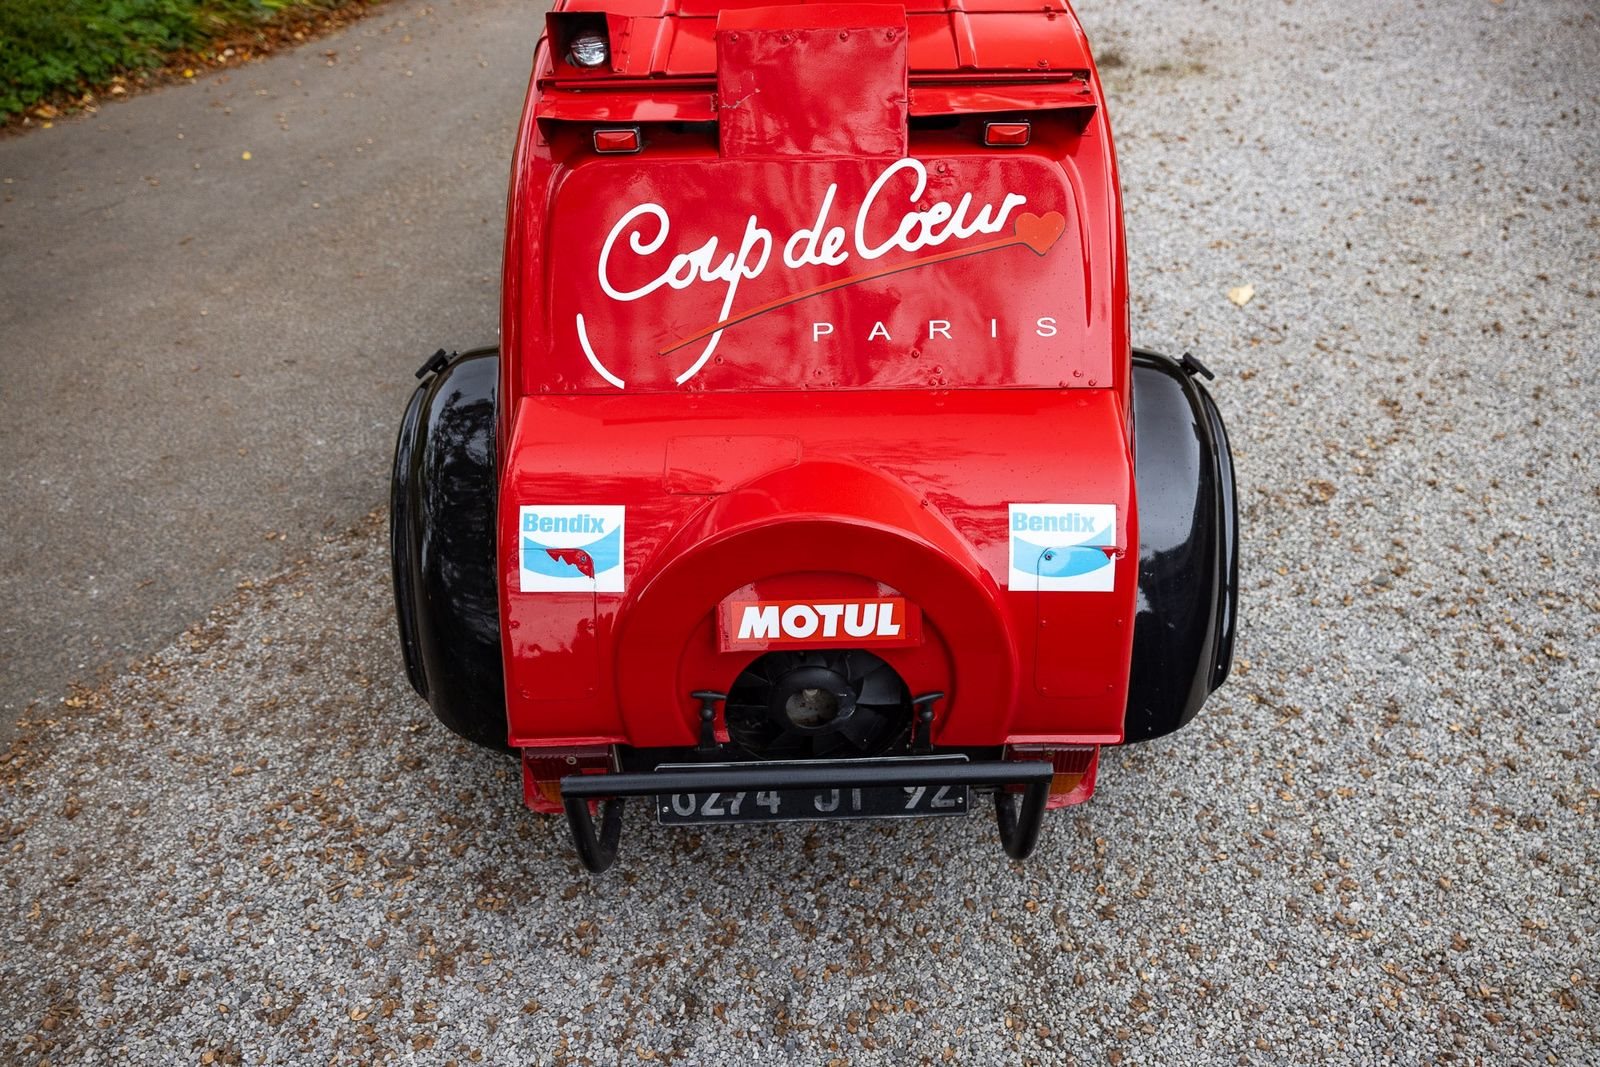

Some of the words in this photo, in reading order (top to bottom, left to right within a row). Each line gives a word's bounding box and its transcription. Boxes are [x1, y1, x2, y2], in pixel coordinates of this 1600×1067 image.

[598, 203, 773, 386] Coup
[783, 183, 849, 269] de
[522, 512, 605, 533] Bendix
[1012, 511, 1096, 533] Bendix
[737, 602, 901, 640] MOTUL
